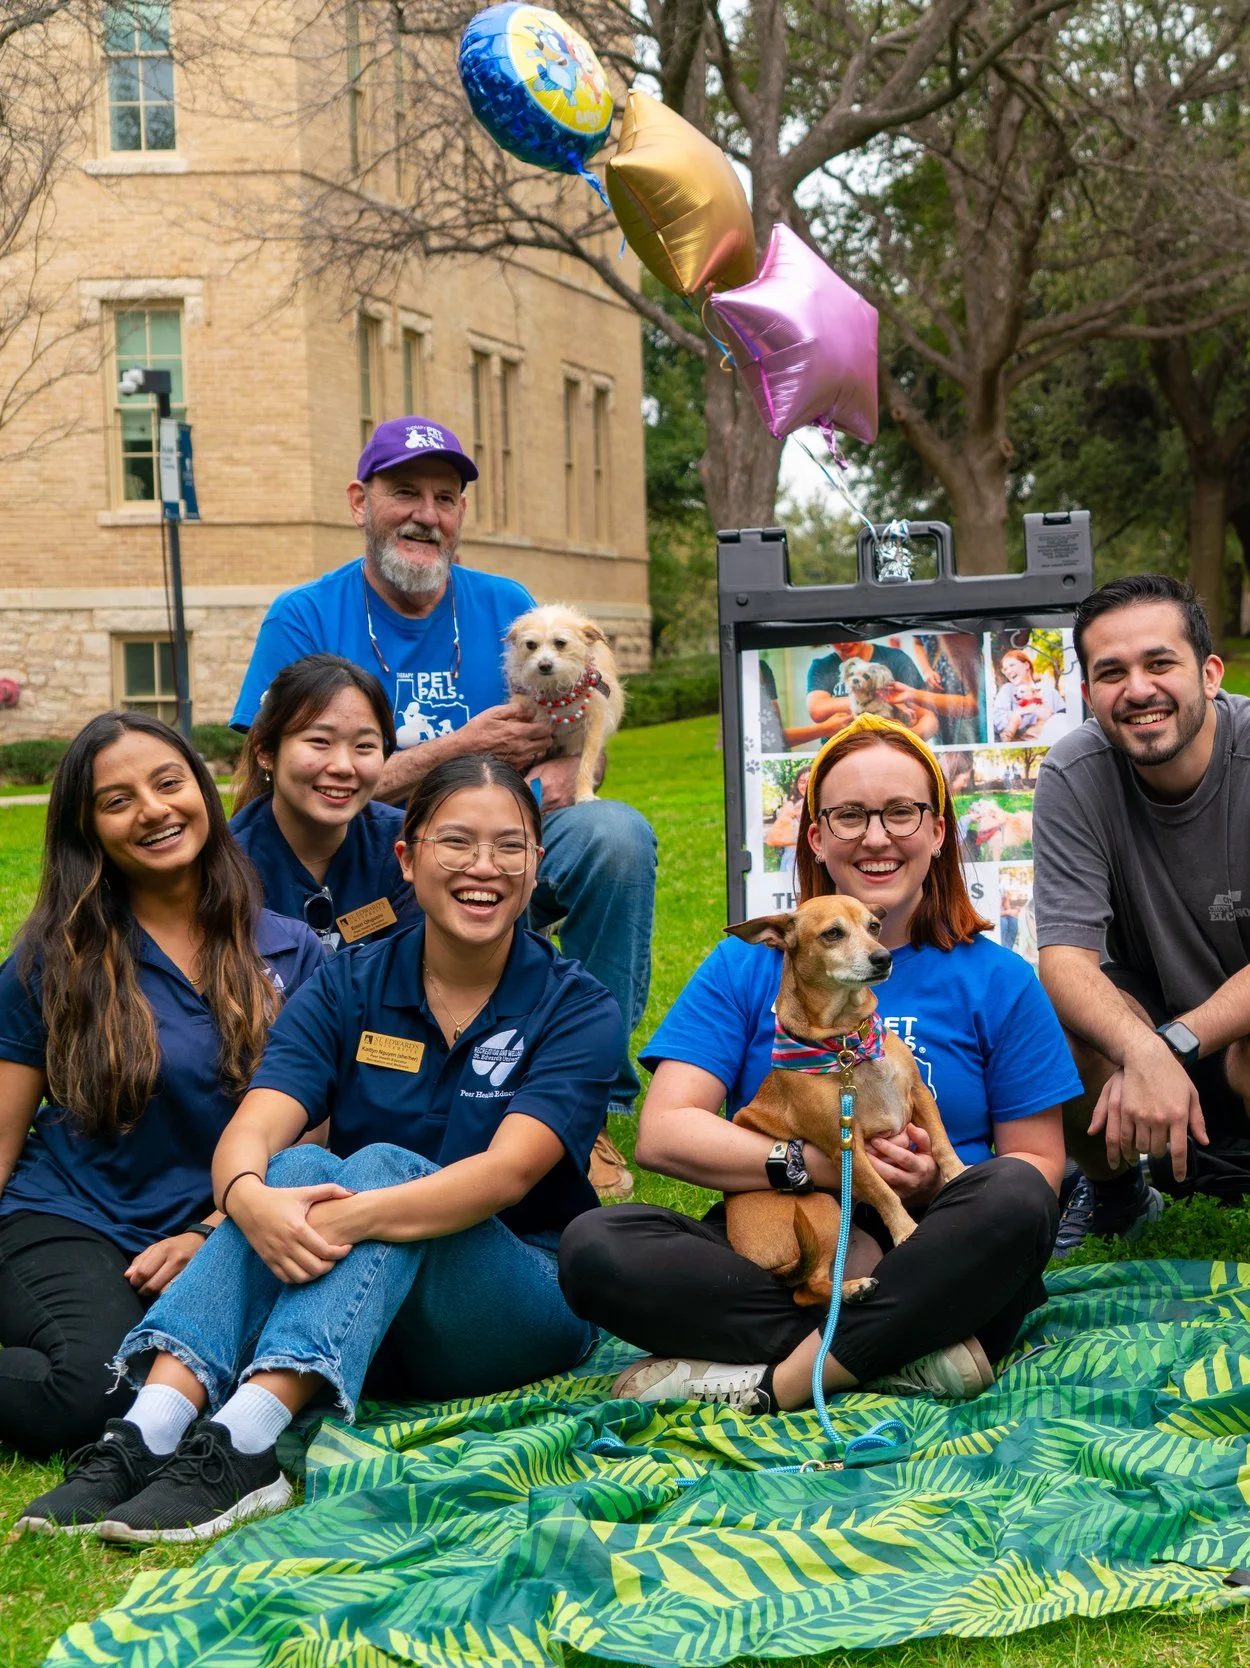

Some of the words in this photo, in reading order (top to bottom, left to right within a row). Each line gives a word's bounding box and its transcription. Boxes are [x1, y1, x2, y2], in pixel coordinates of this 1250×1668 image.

[417, 671, 453, 688] PET
[884, 1016, 918, 1036] ET
[460, 1089, 475, 1097] Peer
